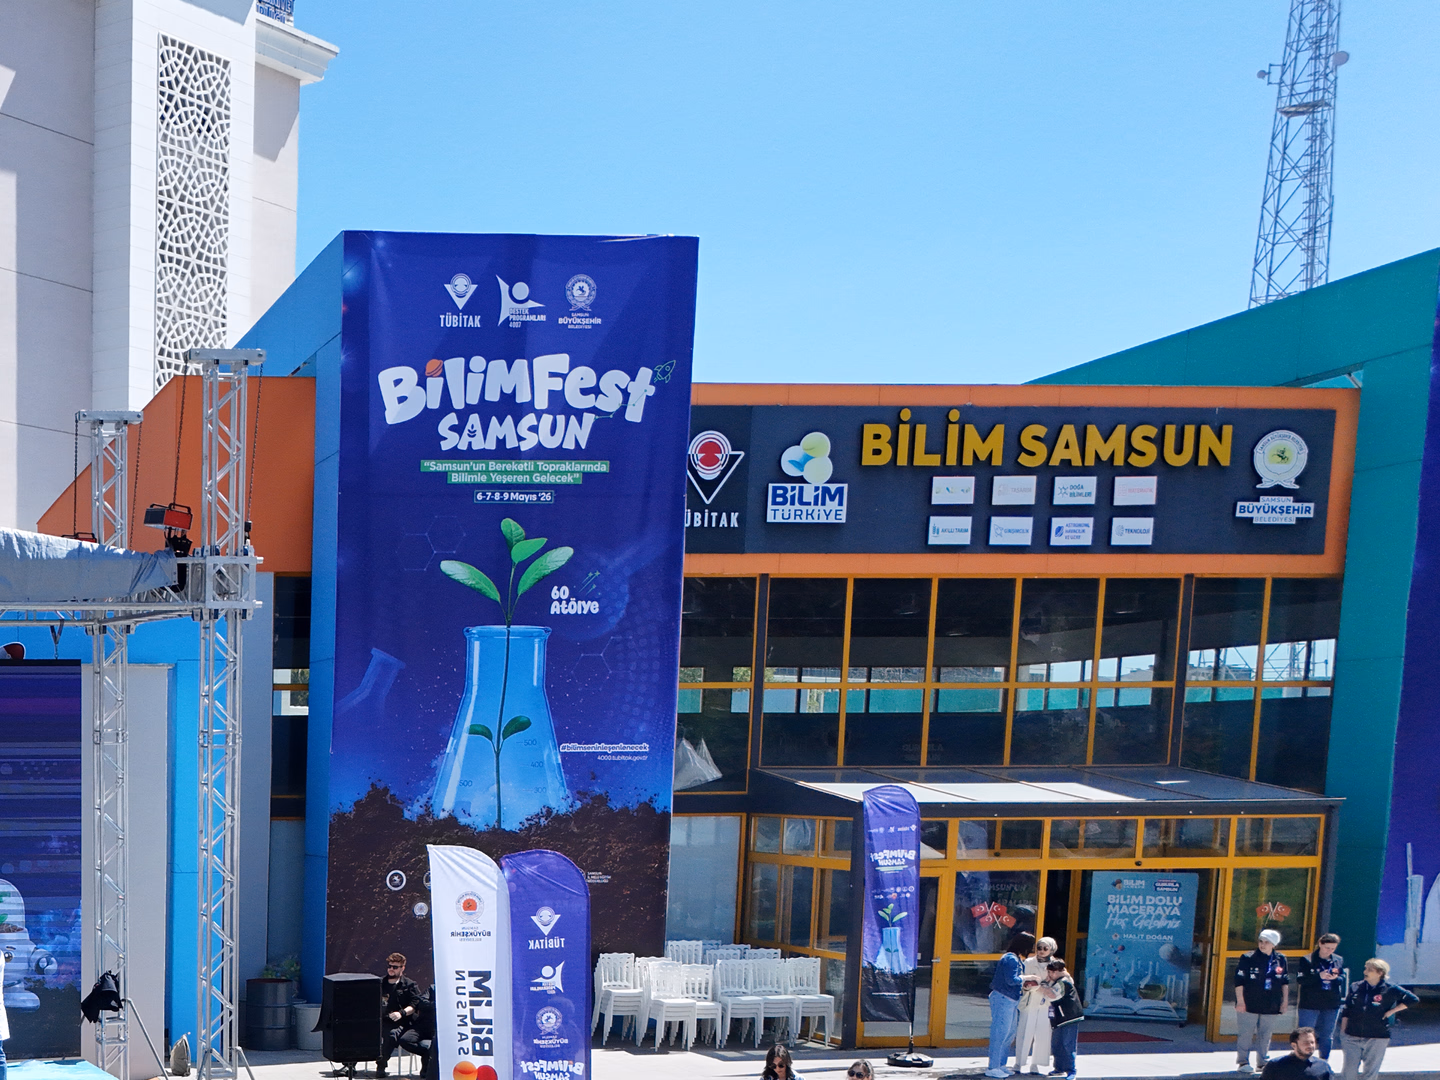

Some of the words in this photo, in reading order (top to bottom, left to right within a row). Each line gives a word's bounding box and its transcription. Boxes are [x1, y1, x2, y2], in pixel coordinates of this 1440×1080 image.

[440, 312, 481, 328] TÜBİTAK
[558, 316, 602, 325] BÜYÜKŞEHİR
[438, 413, 595, 451] SAMSUN
[861, 408, 1005, 466] BİLİM
[1017, 423, 1233, 467] SAMSUN
[488, 461, 534, 471] Bereketli
[536, 462, 607, 473] Topraklarında
[451, 472, 487, 483] Bilimle
[490, 473, 530, 484] Yeşeren
[476, 492, 509, 501] 6-7-8-9
[510, 492, 537, 503] Mayıs
[771, 485, 844, 507] BİLİM
[771, 508, 843, 521] TÜRKİYE
[1238, 503, 1312, 516] BÜYÜKŞEHİR
[685, 508, 739, 528] ÜBİTAK
[550, 585, 569, 600] 60
[1145, 896, 1182, 906] DOLU
[1107, 905, 1181, 916] MACERAYA
